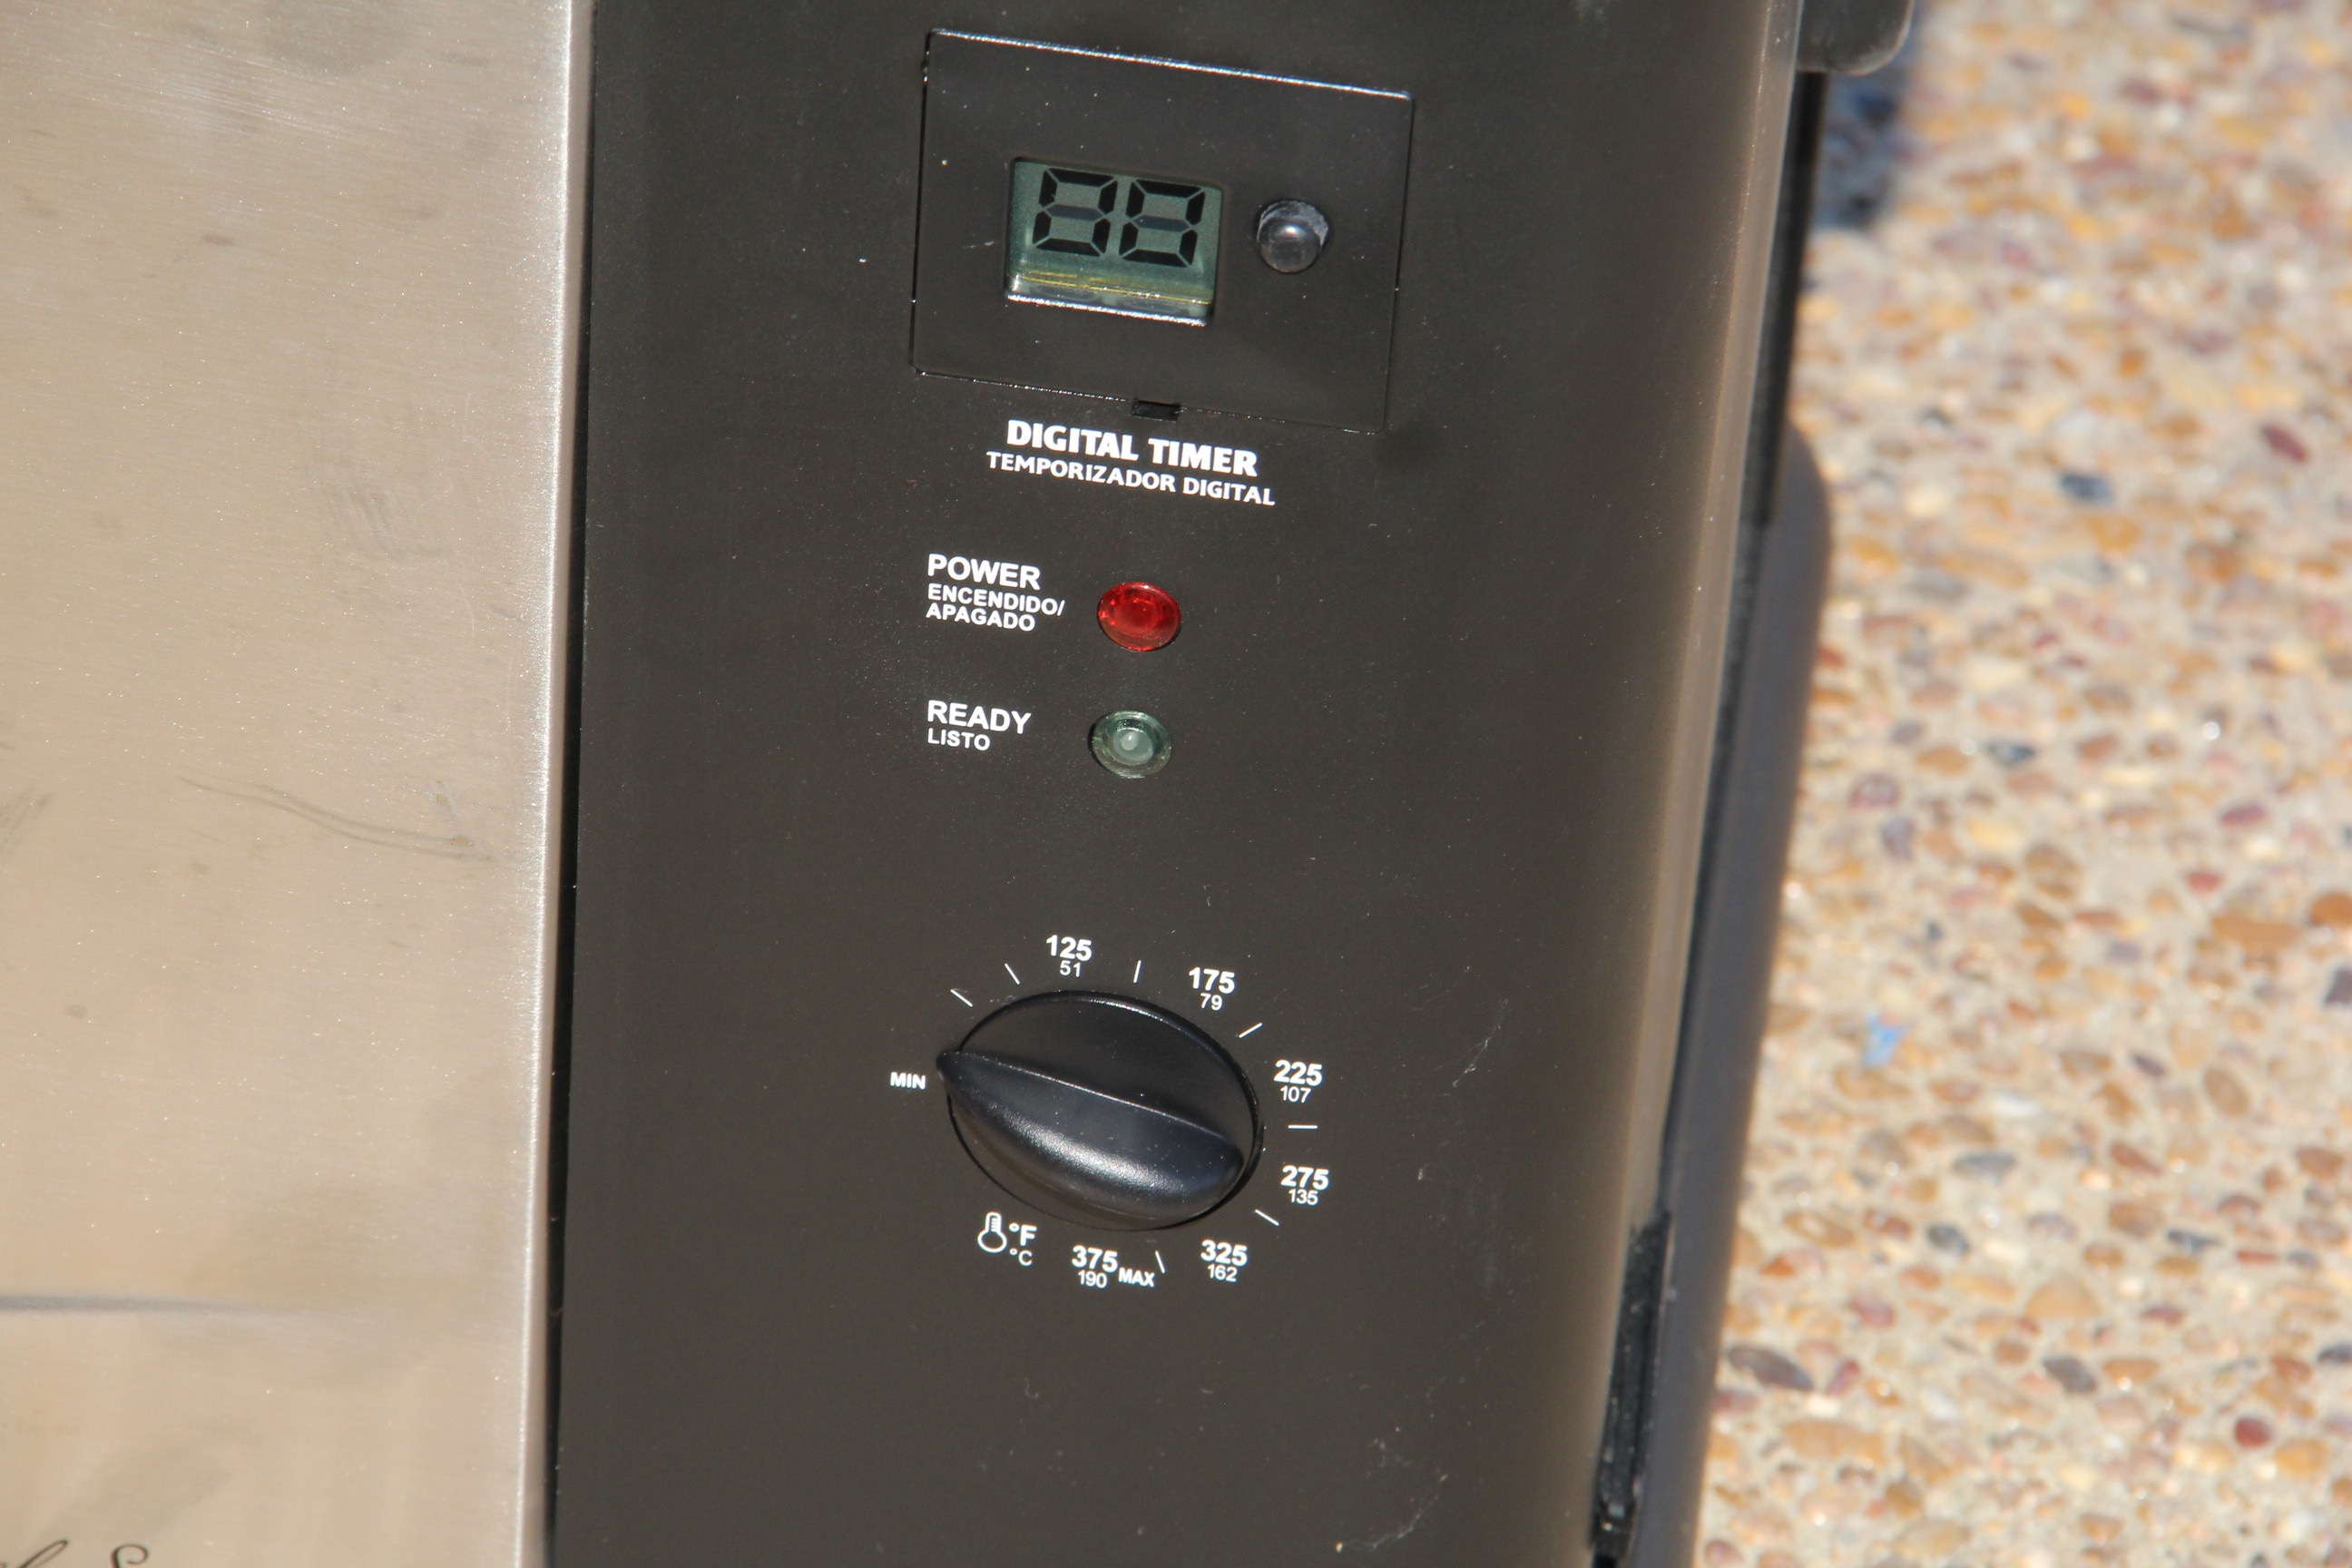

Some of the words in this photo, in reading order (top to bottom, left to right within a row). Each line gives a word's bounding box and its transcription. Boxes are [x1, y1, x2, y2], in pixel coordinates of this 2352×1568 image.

[1006, 418, 1140, 462] DIGITAL
[1147, 437, 1258, 477] TIMER
[985, 450, 1177, 493] TEMPORIZADOR
[1182, 476, 1276, 506] DIGITAL
[927, 553, 1041, 591] POWER
[927, 583, 1066, 617] ENCENDIDO/
[925, 602, 1036, 632] APAGADO
[926, 699, 1032, 735] READY
[927, 727, 991, 751] LISTO
[1045, 934, 1093, 962] 125
[1059, 959, 1082, 978] 51
[1188, 966, 1236, 995] 175
[1200, 992, 1223, 1011] 79
[889, 1071, 926, 1091] MIN
[1273, 1059, 1323, 1087] 225
[1279, 1084, 1312, 1103] 107
[1279, 1164, 1329, 1191] 275
[1288, 1188, 1319, 1206] 135
[1071, 1244, 1119, 1273] 375
[1200, 1239, 1249, 1267] 325
[1077, 1269, 1108, 1289] 190
[1117, 1266, 1155, 1288] MAX
[1207, 1262, 1239, 1283] 162
